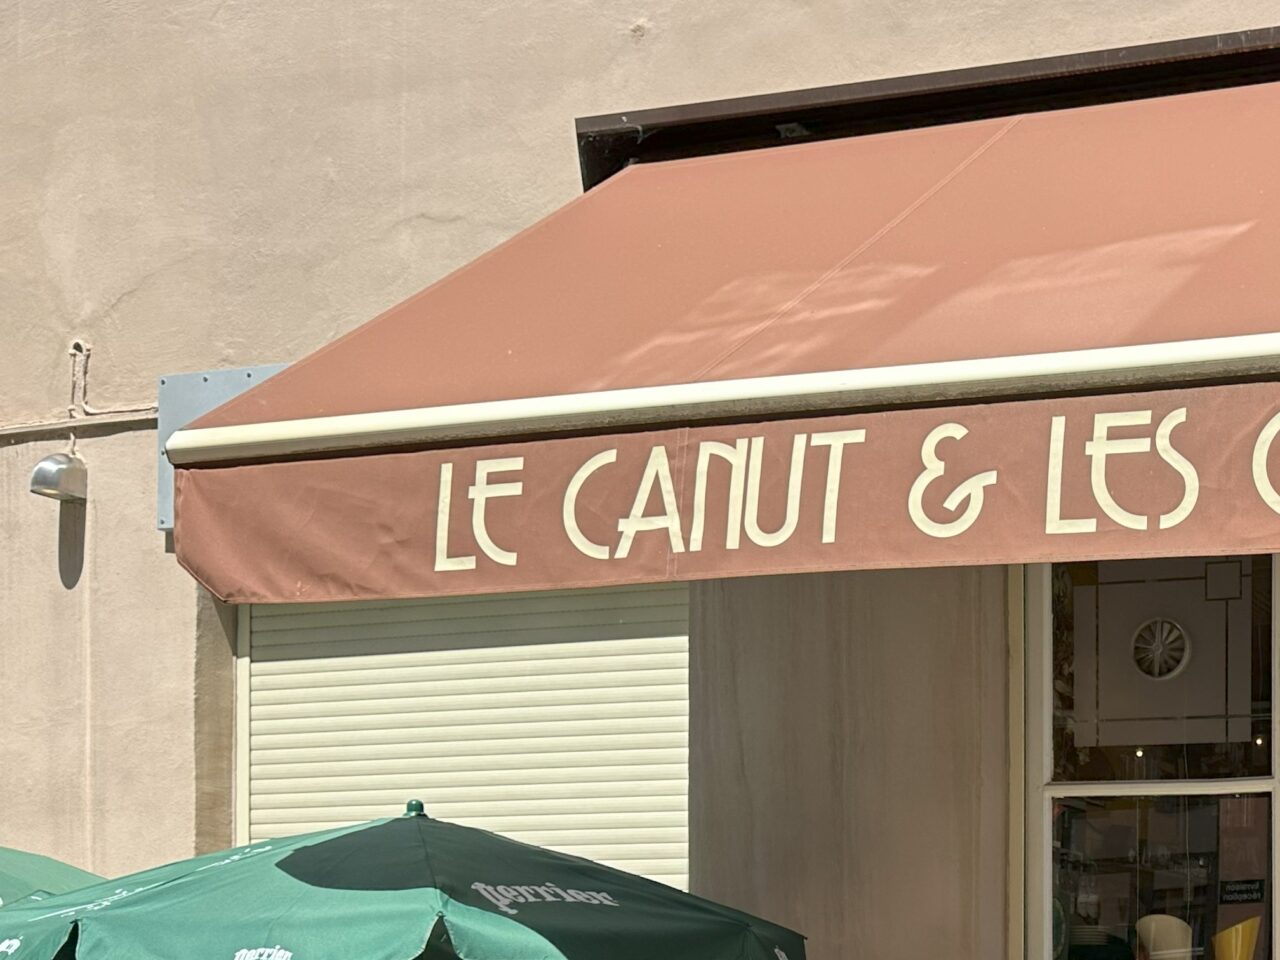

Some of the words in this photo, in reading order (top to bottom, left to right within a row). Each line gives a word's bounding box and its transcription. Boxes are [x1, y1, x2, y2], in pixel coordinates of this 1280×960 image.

[434, 457, 524, 571] LE
[563, 429, 866, 559] CANUT
[908, 423, 997, 538] &
[1045, 407, 1199, 534] LES
[471, 881, 620, 915] perrier
